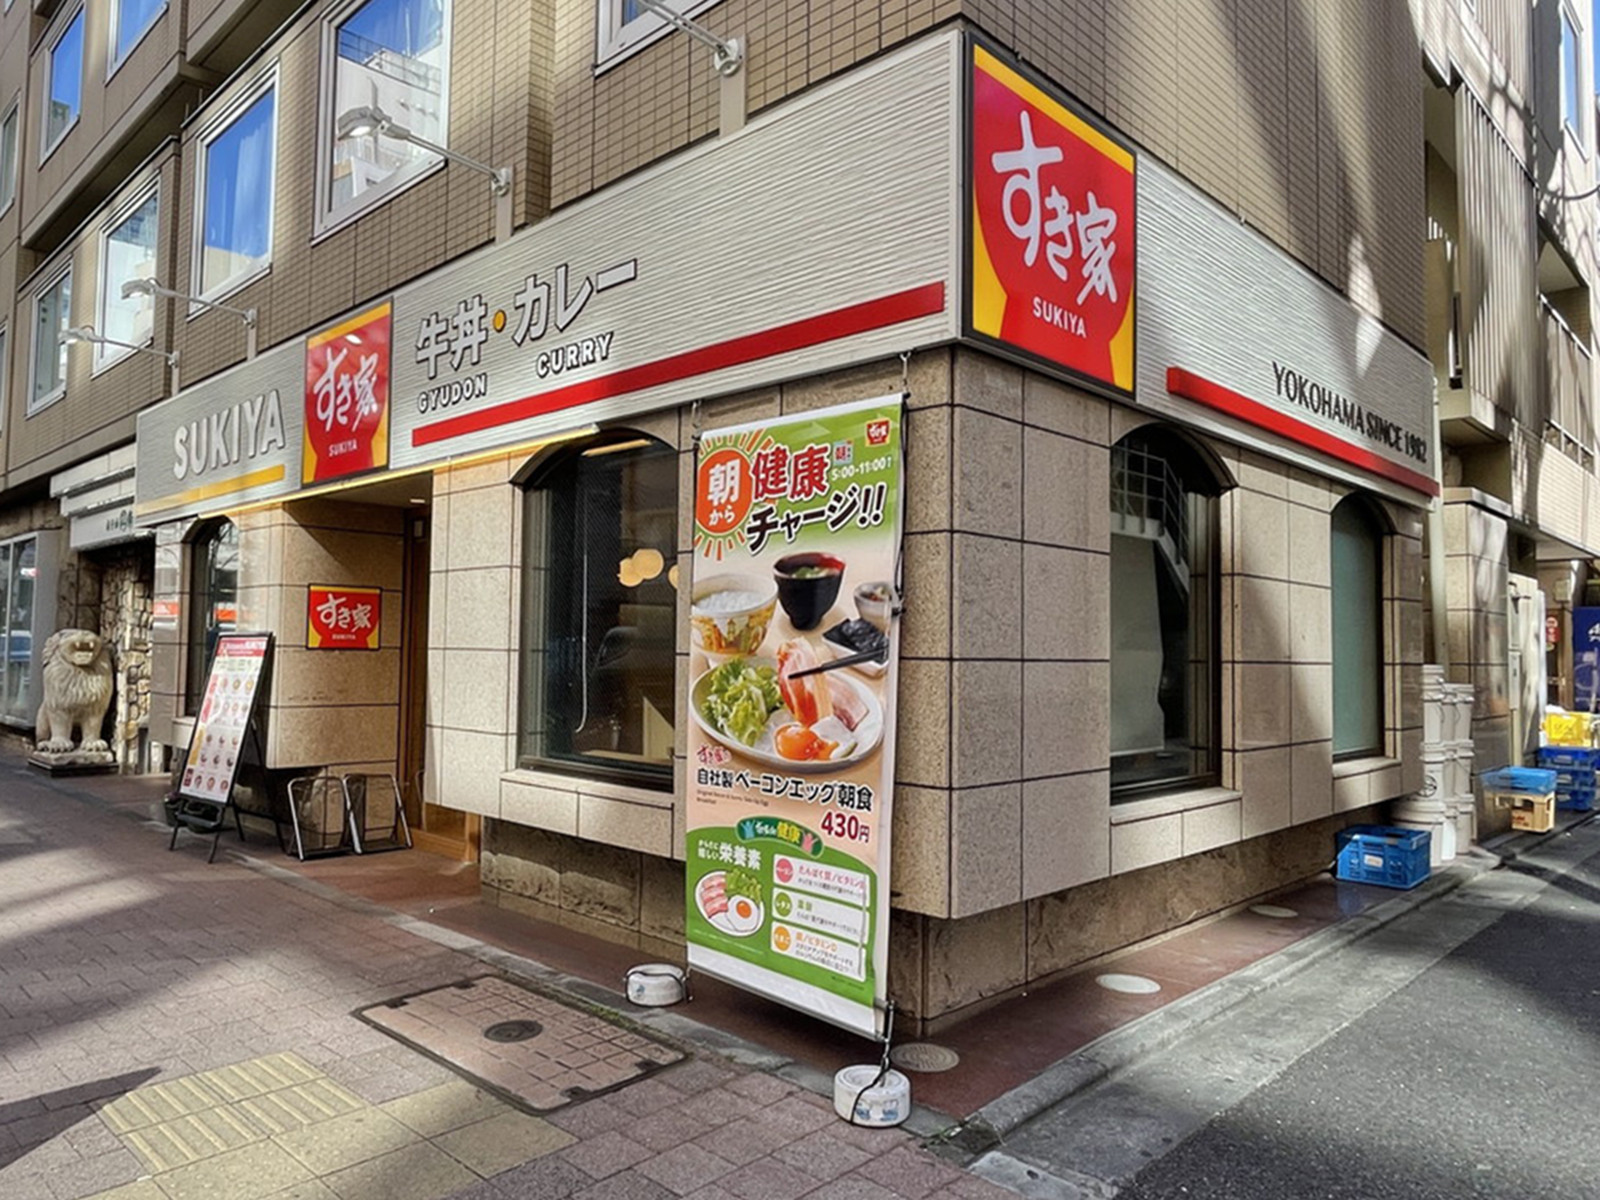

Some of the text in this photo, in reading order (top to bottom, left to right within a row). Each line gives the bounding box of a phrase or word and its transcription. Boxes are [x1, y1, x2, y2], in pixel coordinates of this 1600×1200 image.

[991, 110, 1118, 305] すき家
[1032, 296, 1087, 339] SUKIYA
[536, 331, 615, 379] CURRY
[312, 345, 379, 433] すき家
[418, 373, 488, 414] GYUDON
[1272, 361, 1427, 464] YOKOHAMA SINCE 1982
[172, 389, 286, 481] SUKIYA
[328, 438, 358, 457] SUKIYA
[707, 459, 741, 506] 朝
[751, 445, 830, 500] 健康
[708, 505, 736, 526] から
[316, 593, 372, 633] すき家
[821, 811, 871, 844] 430円
